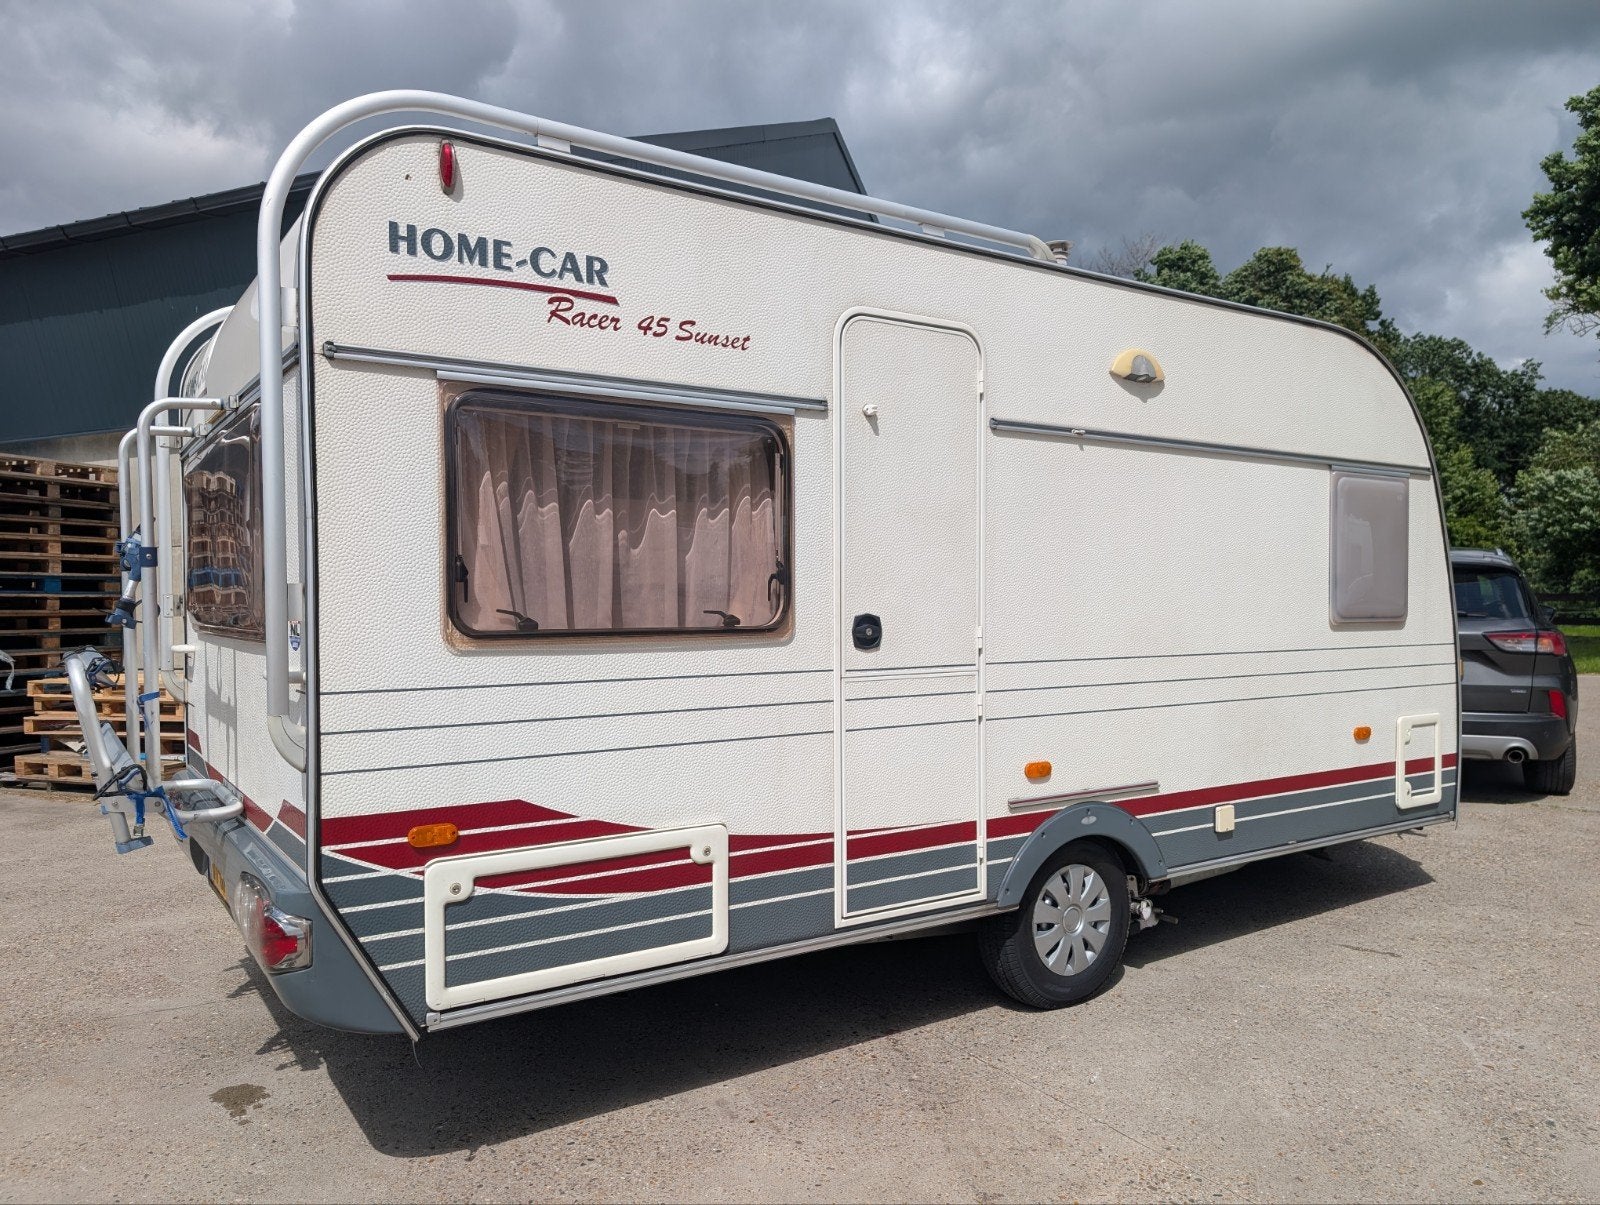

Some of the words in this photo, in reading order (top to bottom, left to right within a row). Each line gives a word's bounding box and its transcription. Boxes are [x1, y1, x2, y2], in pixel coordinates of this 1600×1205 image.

[388, 220, 609, 288] HOME-CAR
[547, 296, 621, 332] Racer
[637, 316, 669, 338] 45
[674, 320, 751, 351] Sunset
[290, 624, 300, 636] NL
